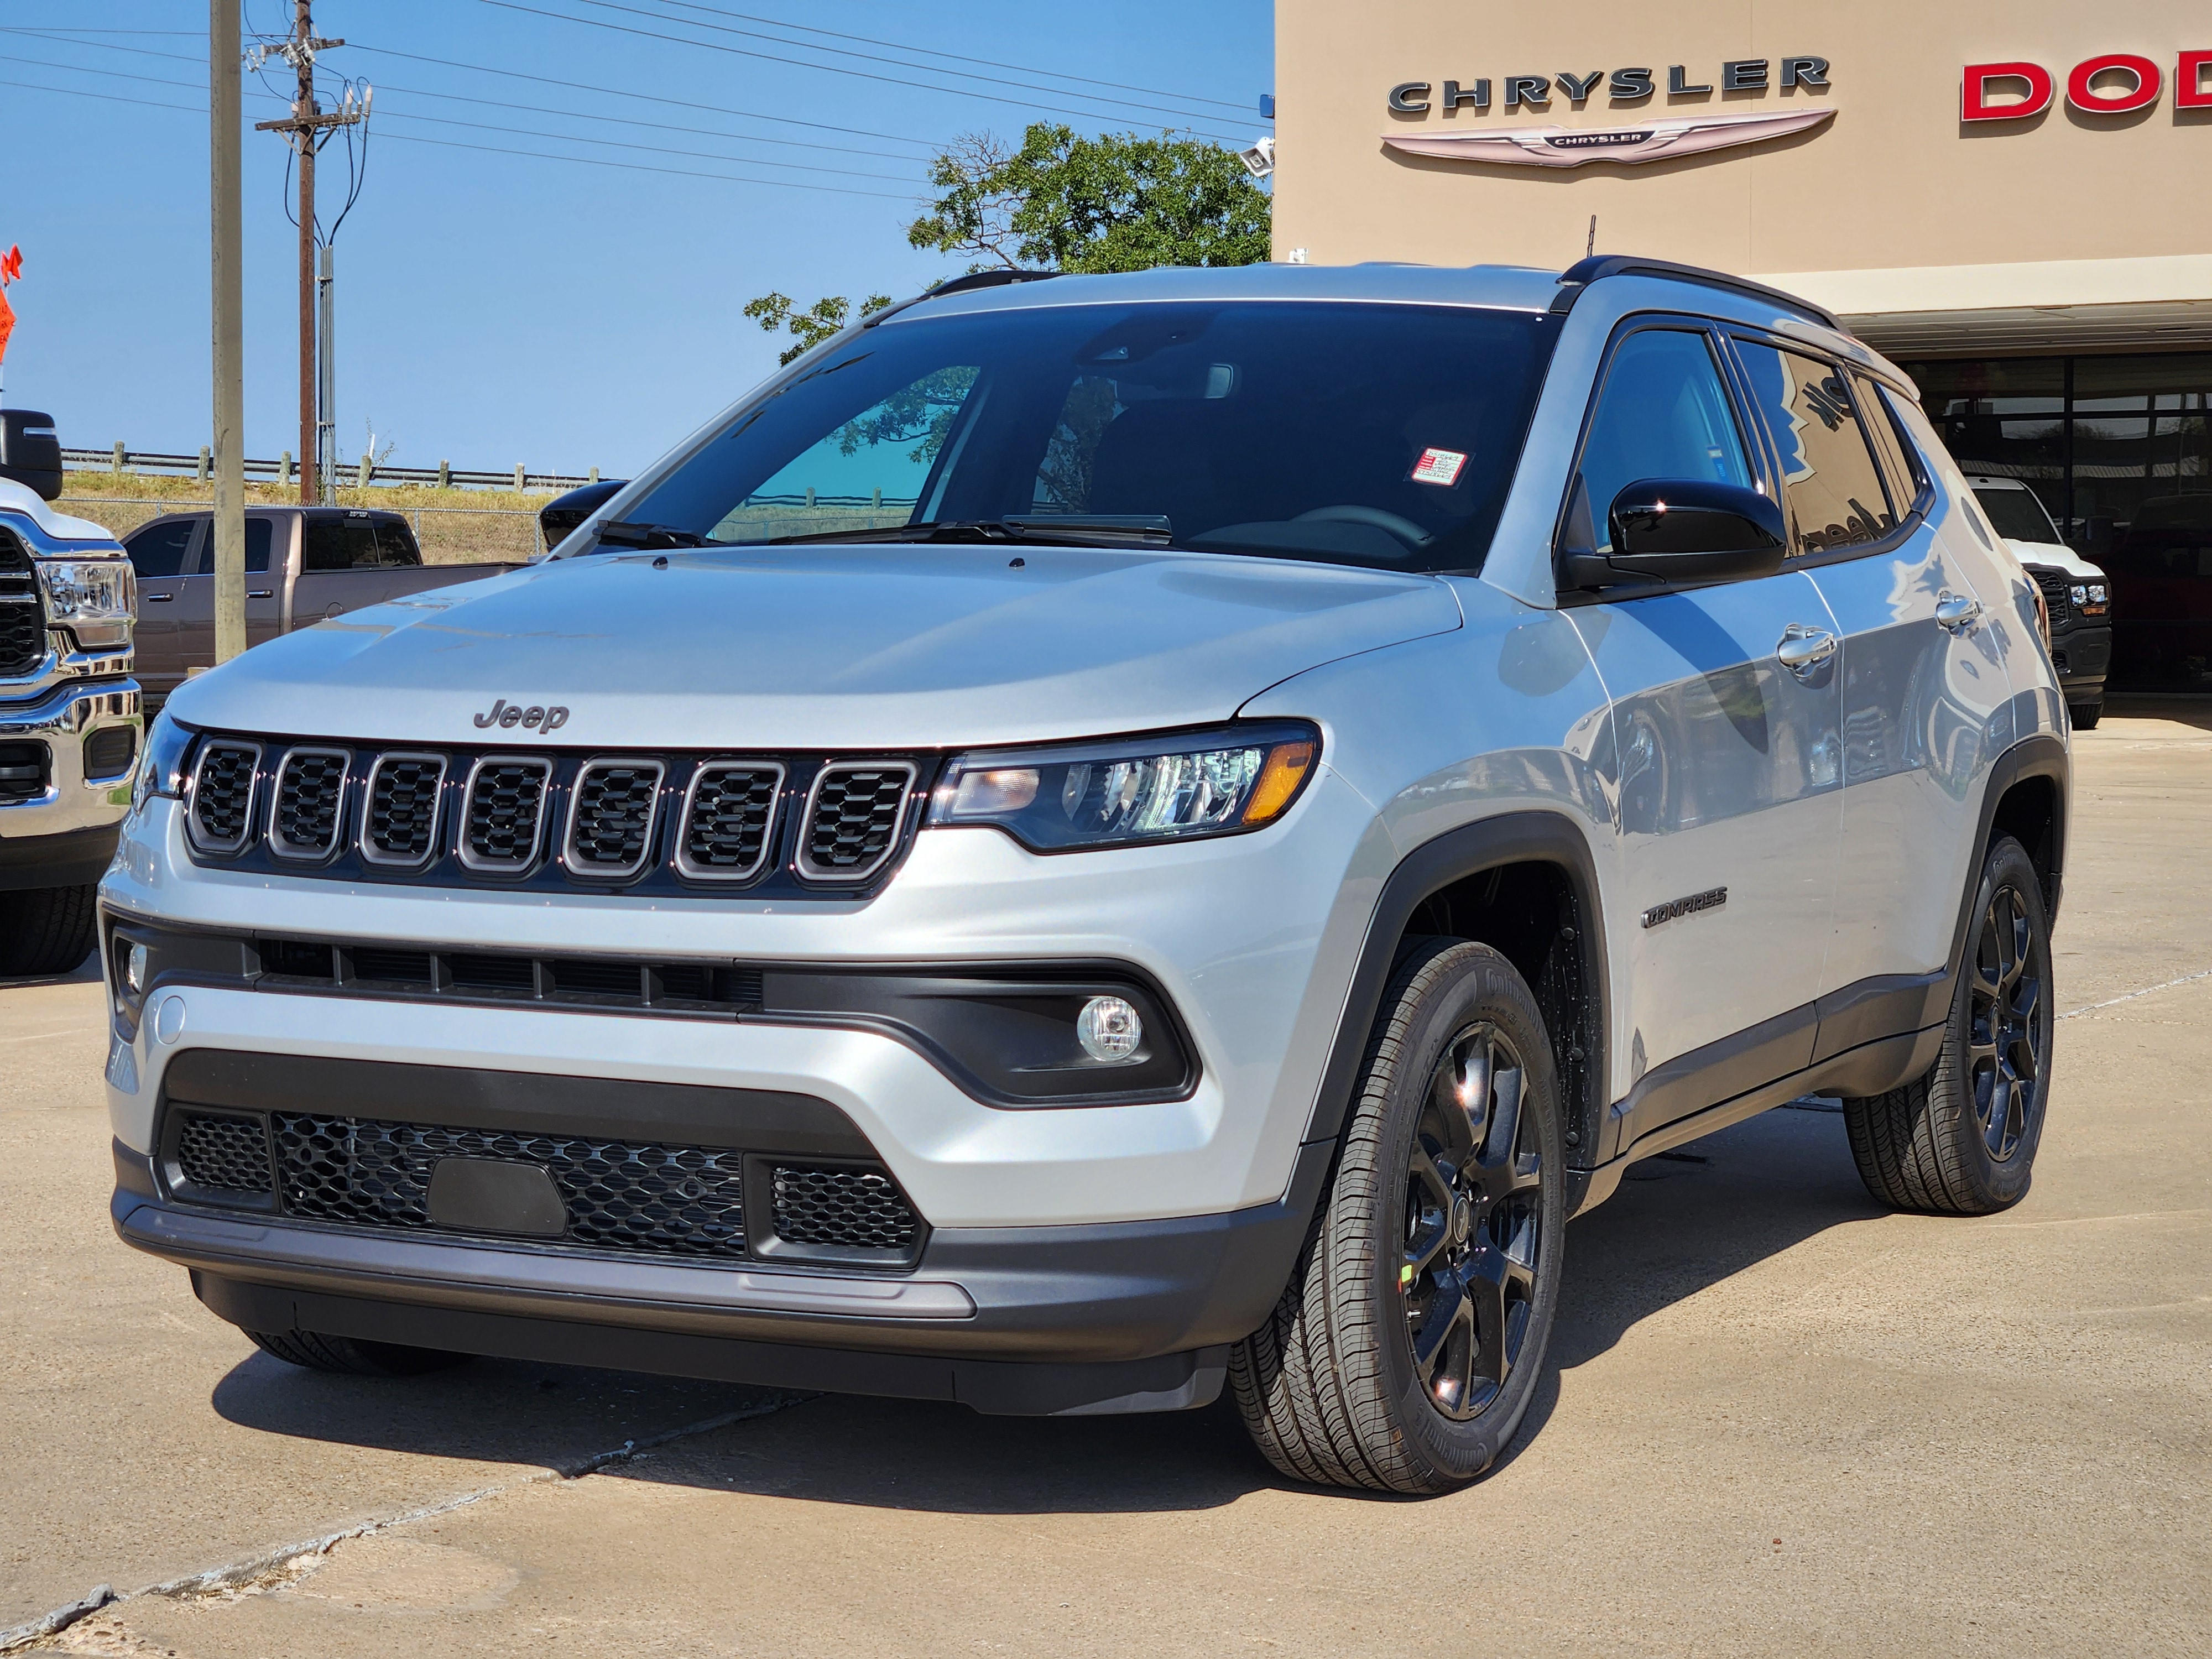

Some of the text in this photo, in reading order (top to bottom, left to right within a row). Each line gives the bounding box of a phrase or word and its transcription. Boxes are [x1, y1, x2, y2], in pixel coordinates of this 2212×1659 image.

[1387, 55, 1830, 111] CHRYSLER
[1554, 133, 1642, 147] CHRYSLER
[473, 699, 570, 735] Jeep
[1640, 886, 1728, 928] COMPASS
